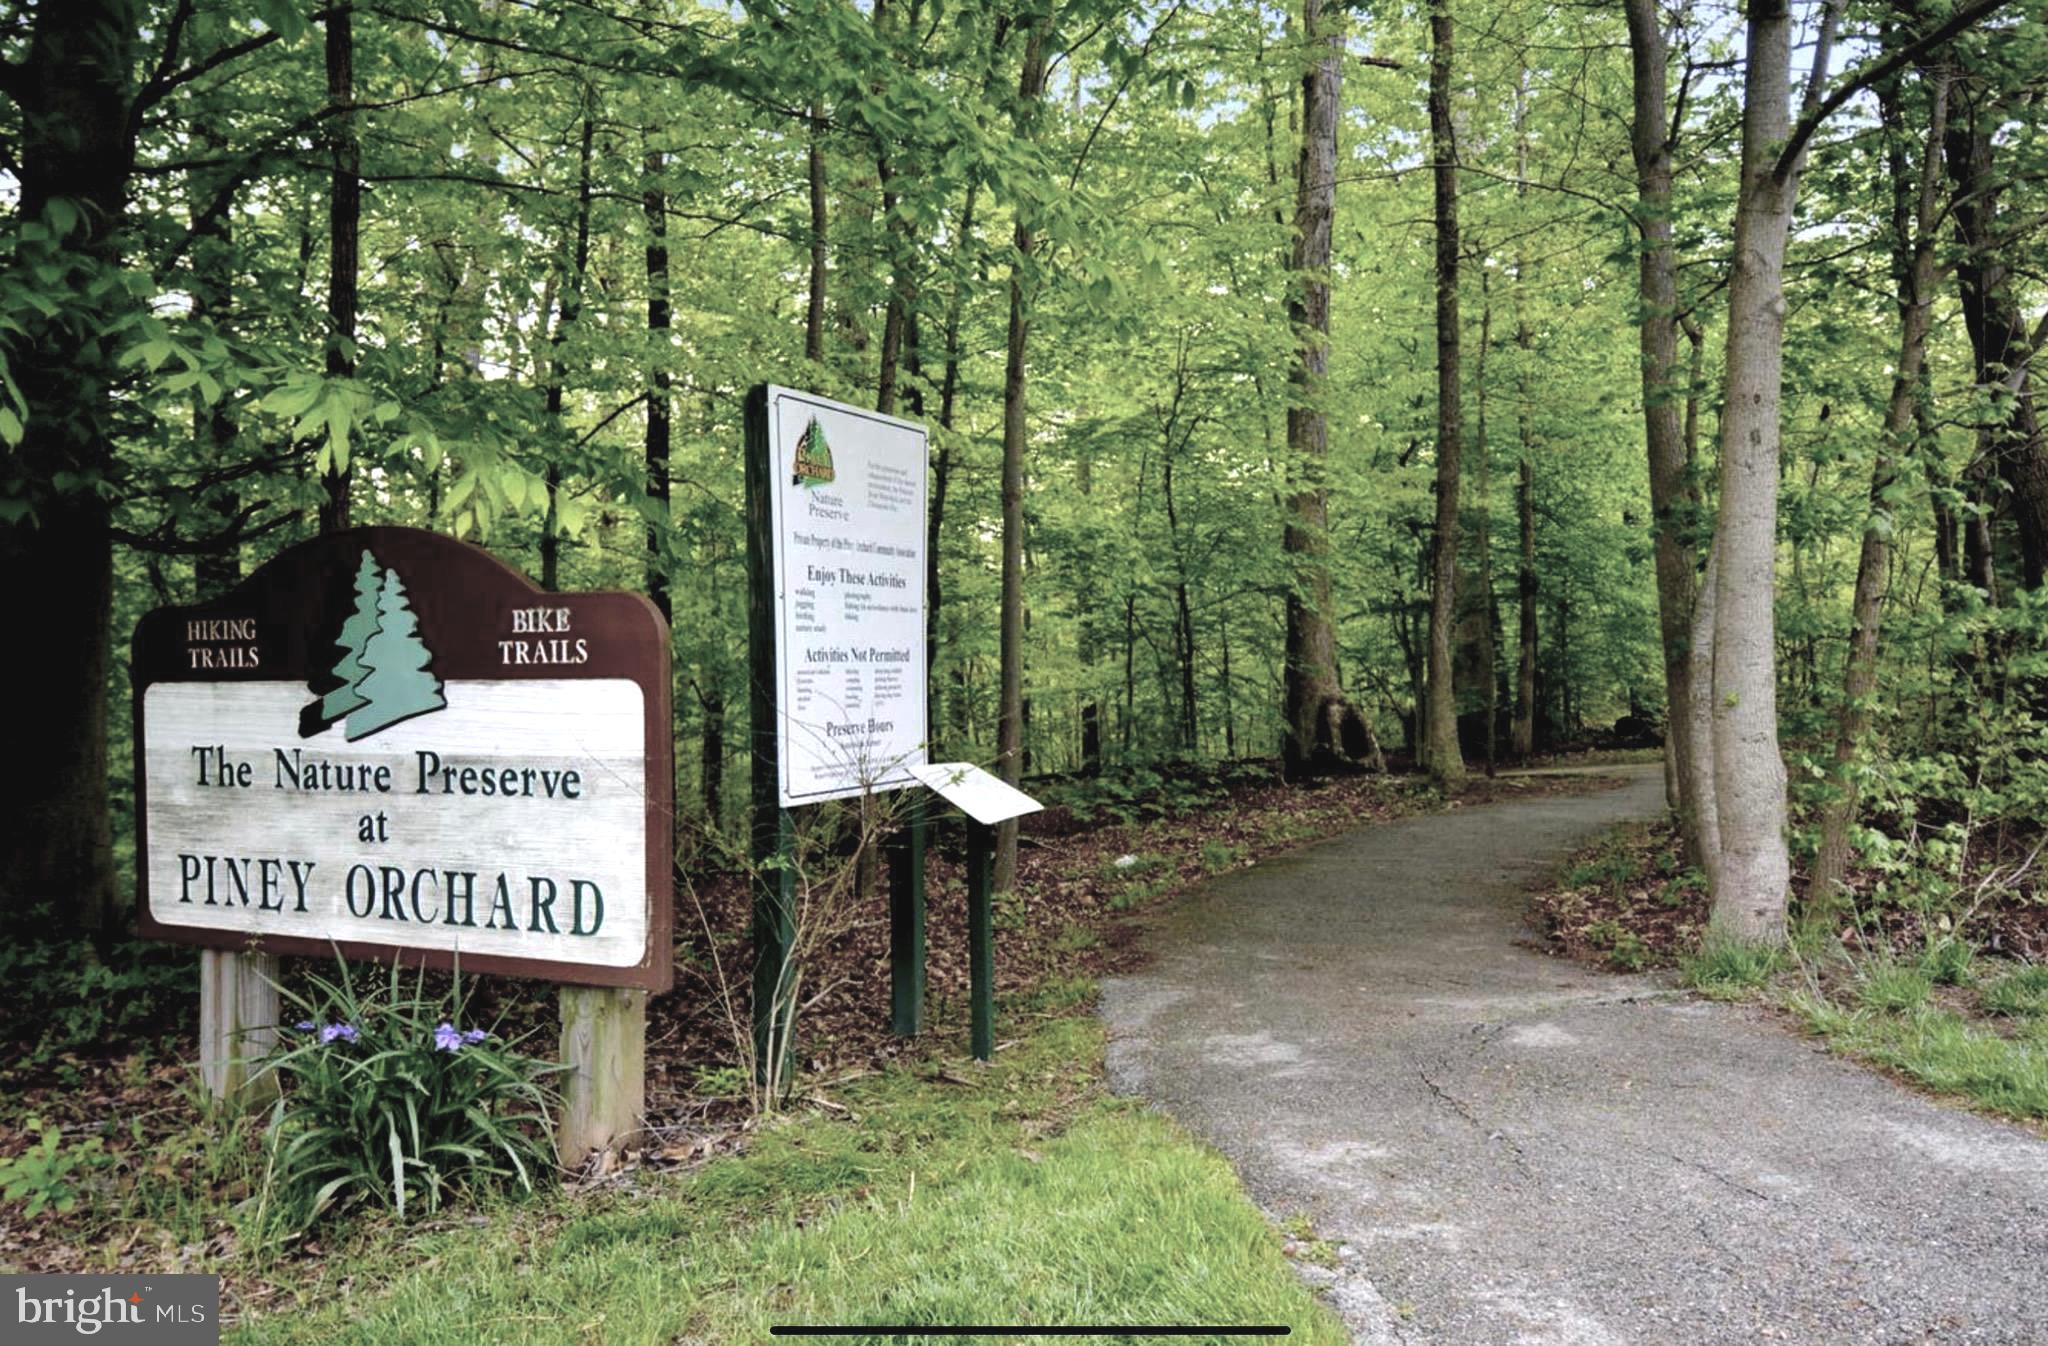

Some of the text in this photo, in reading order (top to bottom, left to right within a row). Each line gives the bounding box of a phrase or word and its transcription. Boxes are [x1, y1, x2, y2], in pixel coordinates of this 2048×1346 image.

[811, 489, 844, 507] Nature
[808, 503, 850, 521] Preserve
[807, 565, 907, 589] Enjoy These Activities
[187, 618, 256, 641] HIKING
[512, 606, 571, 633] BIKE
[187, 646, 259, 668] TRAILS
[498, 639, 588, 664] TRAILS
[804, 646, 910, 663] Activities Not Permitted
[826, 718, 894, 737] Preserve Hours
[192, 745, 581, 799] The Nature Preserve
[358, 810, 389, 843] at
[178, 854, 605, 937] PINEY ORCHARD
